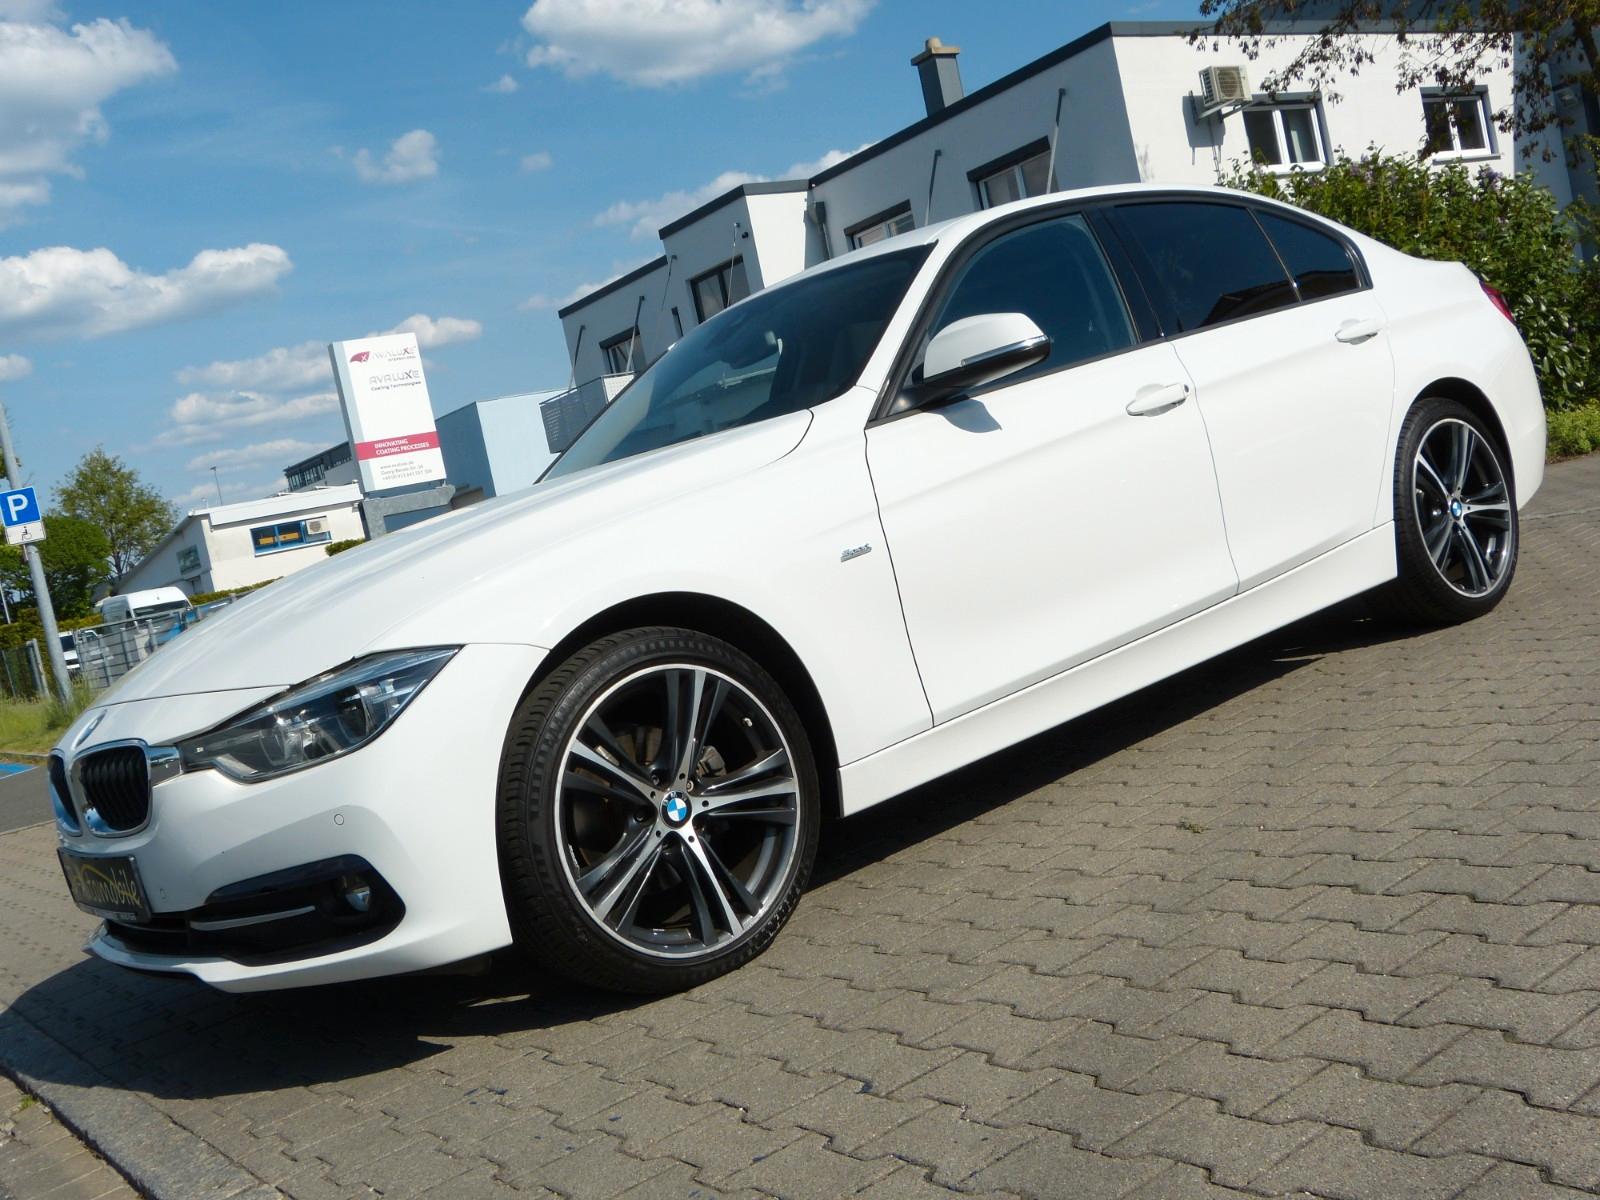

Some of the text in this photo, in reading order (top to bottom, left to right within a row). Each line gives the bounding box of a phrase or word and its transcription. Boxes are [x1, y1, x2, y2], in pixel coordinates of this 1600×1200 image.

[369, 369, 420, 384] AVALUXE
[374, 439, 408, 449] INNOVATING
[376, 442, 429, 455] COATING PROCESSES
[7, 494, 28, 521] P
